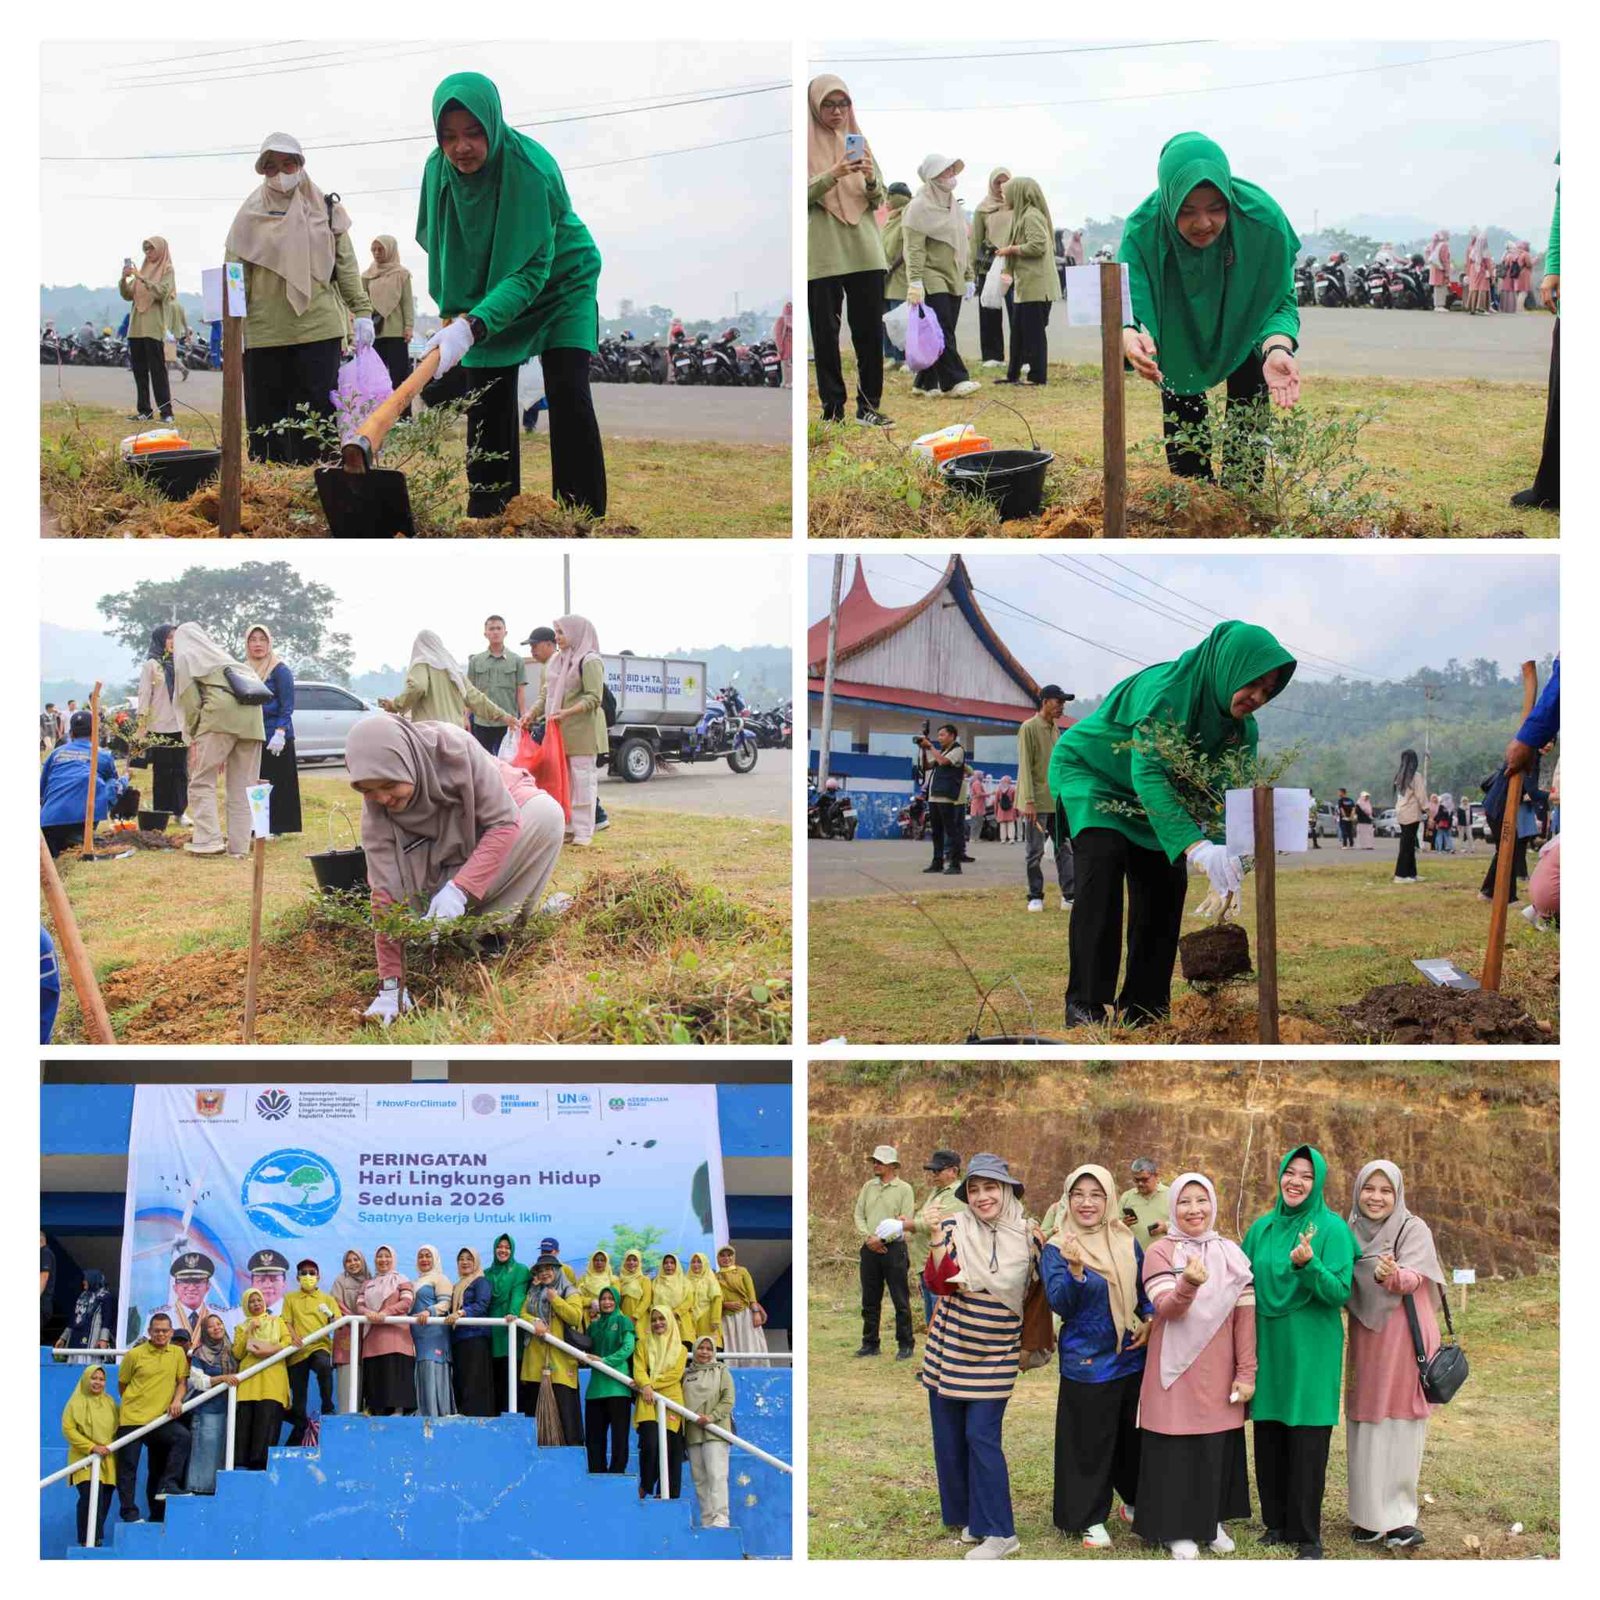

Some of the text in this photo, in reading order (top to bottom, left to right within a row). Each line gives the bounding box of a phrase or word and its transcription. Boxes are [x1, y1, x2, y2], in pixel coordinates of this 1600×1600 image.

[626, 673, 639, 682] BID
[641, 674, 650, 683] LH
[376, 1099, 457, 1108] #NowForClimate
[557, 1093, 577, 1104] UN
[359, 1153, 487, 1167] PERINGATAN
[359, 1170, 602, 1188] Hari Lingkungan Hidup
[358, 1191, 505, 1207] Sedunia 2026
[358, 1211, 552, 1225] Saatnya Bekerja Untuk Iklim
